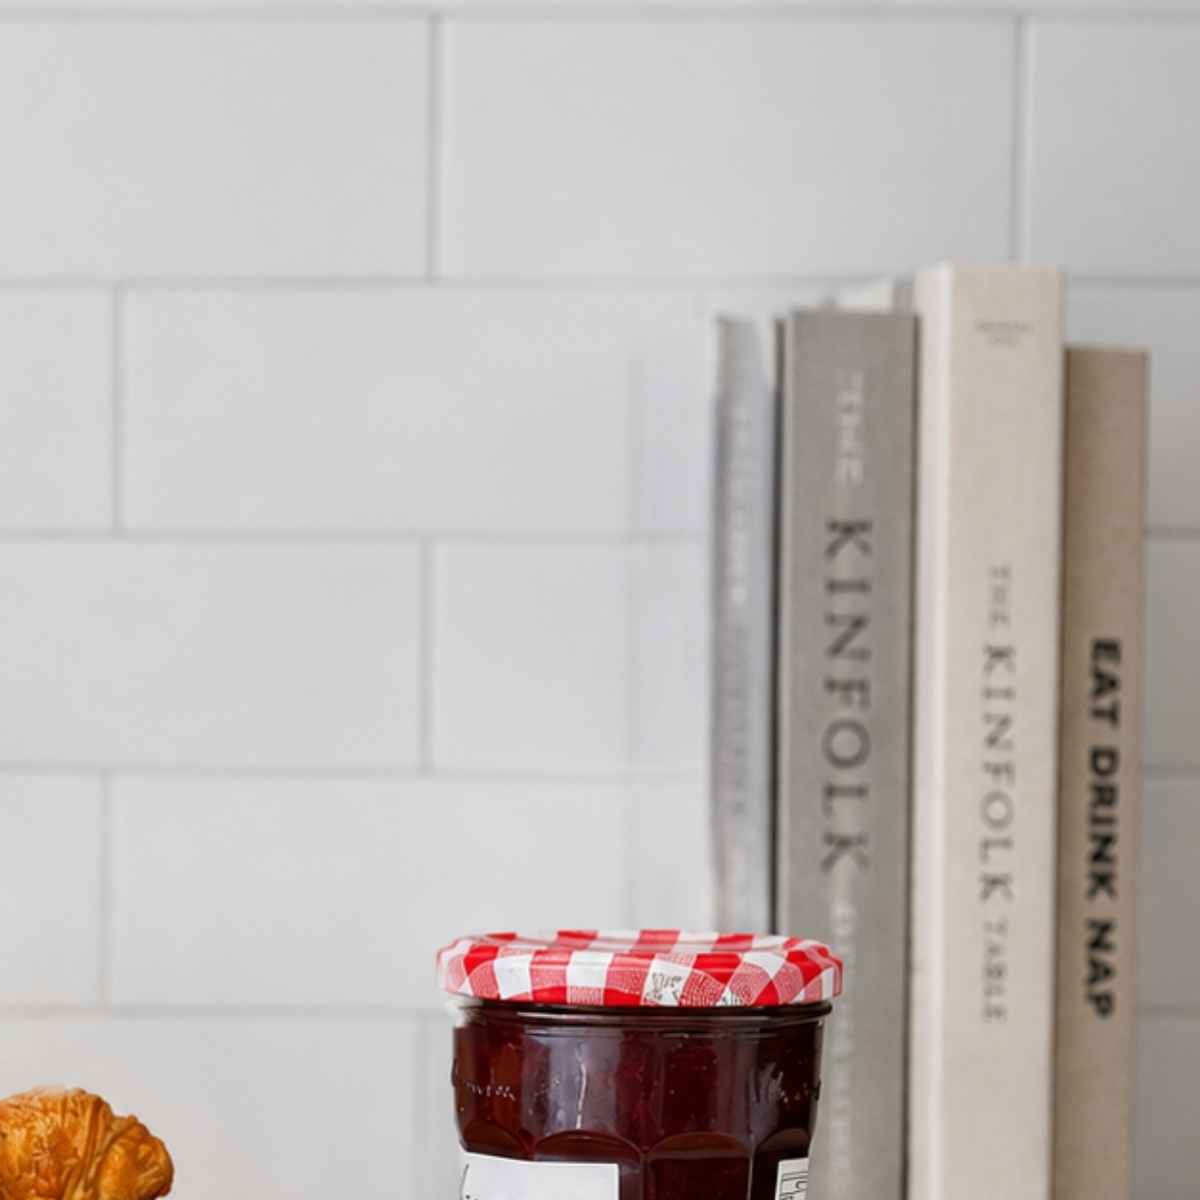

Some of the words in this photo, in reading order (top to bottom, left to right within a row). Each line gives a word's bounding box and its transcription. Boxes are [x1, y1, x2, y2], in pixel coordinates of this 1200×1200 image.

[822, 519, 872, 873] KINFOLK
[1089, 639, 1121, 730] EAT
[978, 644, 1017, 903] KINFOLK
[1088, 746, 1120, 899] DRINK
[981, 918, 1009, 1023] TABLE
[1087, 919, 1118, 1020] NAP
